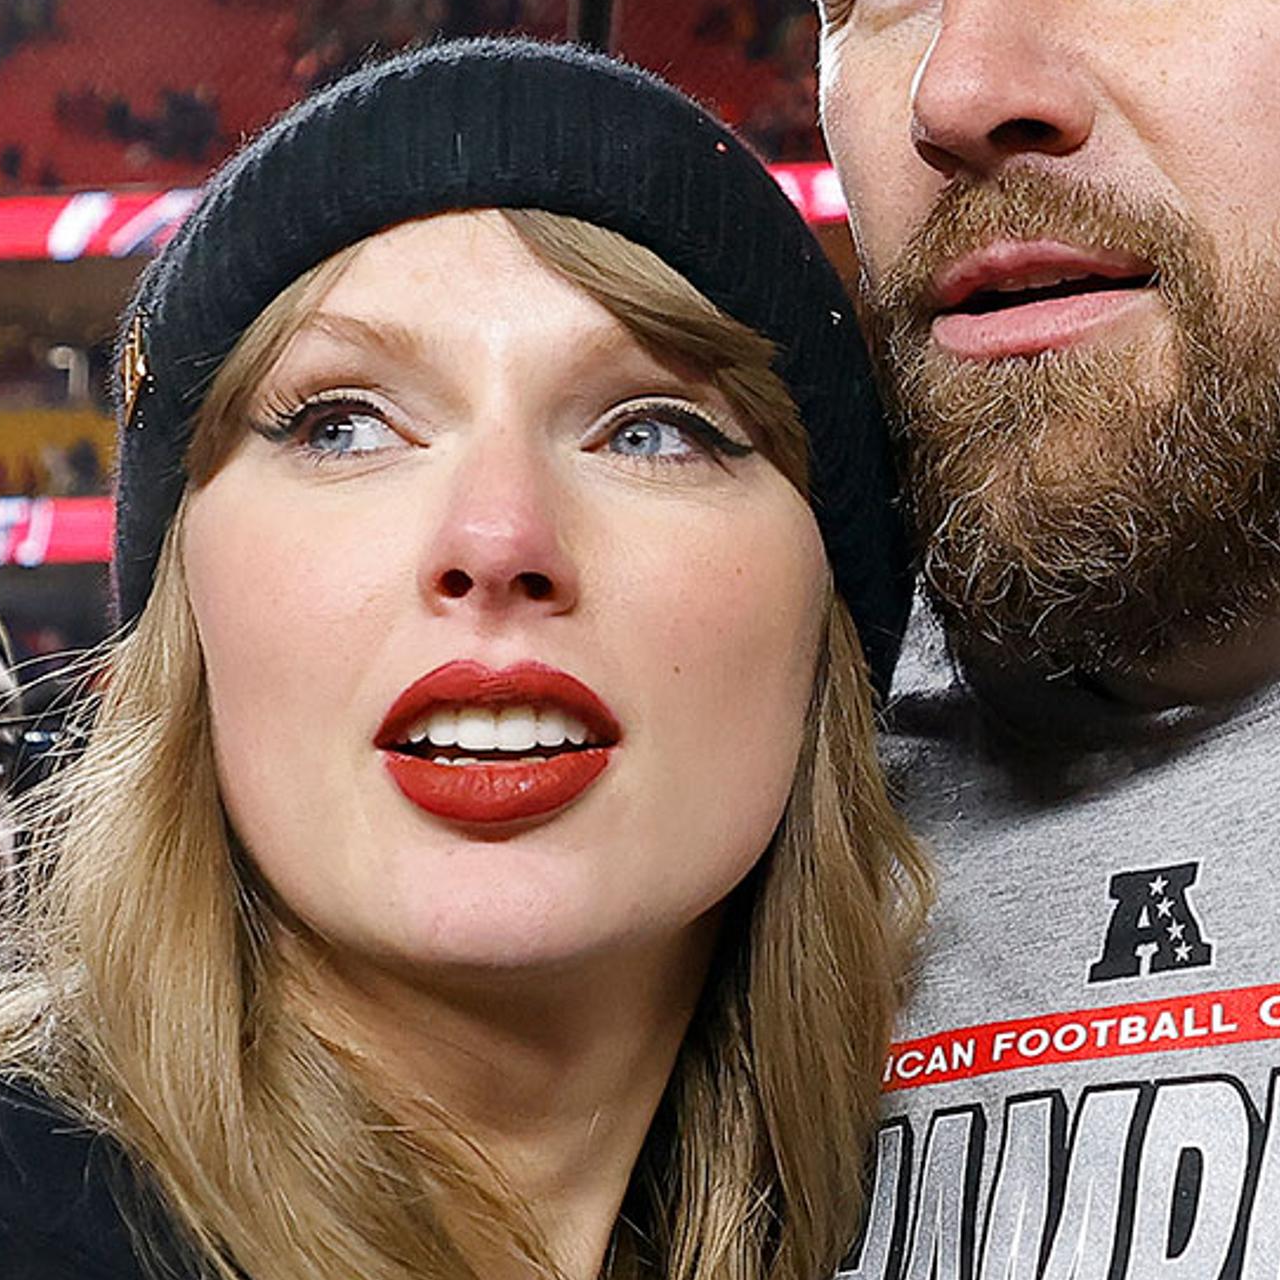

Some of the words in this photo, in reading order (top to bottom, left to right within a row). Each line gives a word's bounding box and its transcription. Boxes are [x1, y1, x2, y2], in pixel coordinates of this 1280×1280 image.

[1087, 861, 1212, 983] A
[881, 1038, 976, 1083] ICAN
[991, 1003, 1238, 1063] FOOTBALL
